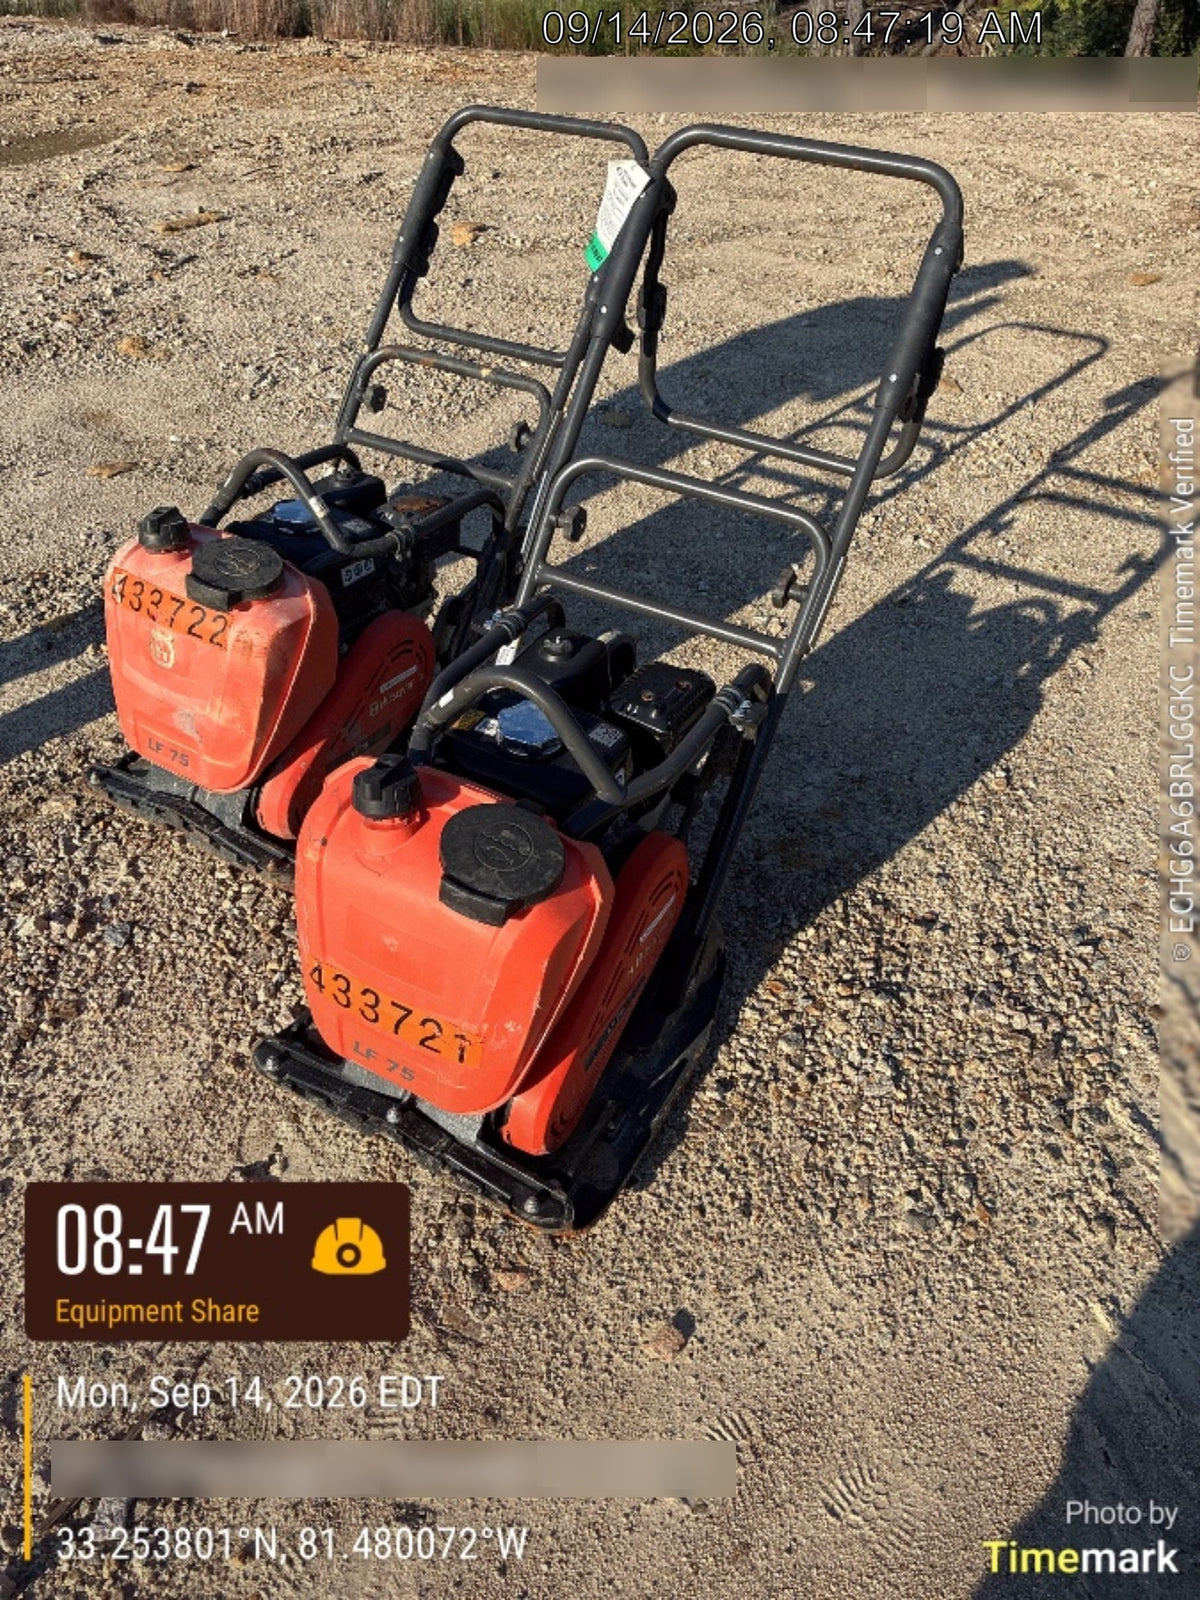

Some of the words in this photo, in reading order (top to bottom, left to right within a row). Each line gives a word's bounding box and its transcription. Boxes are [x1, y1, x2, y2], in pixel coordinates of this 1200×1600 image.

[111, 575, 228, 648] 433722
[148, 737, 165, 753] LF
[169, 748, 189, 767] 75
[309, 963, 472, 1063] 433721
[353, 1040, 378, 1060] LF
[386, 1059, 416, 1082] 75
